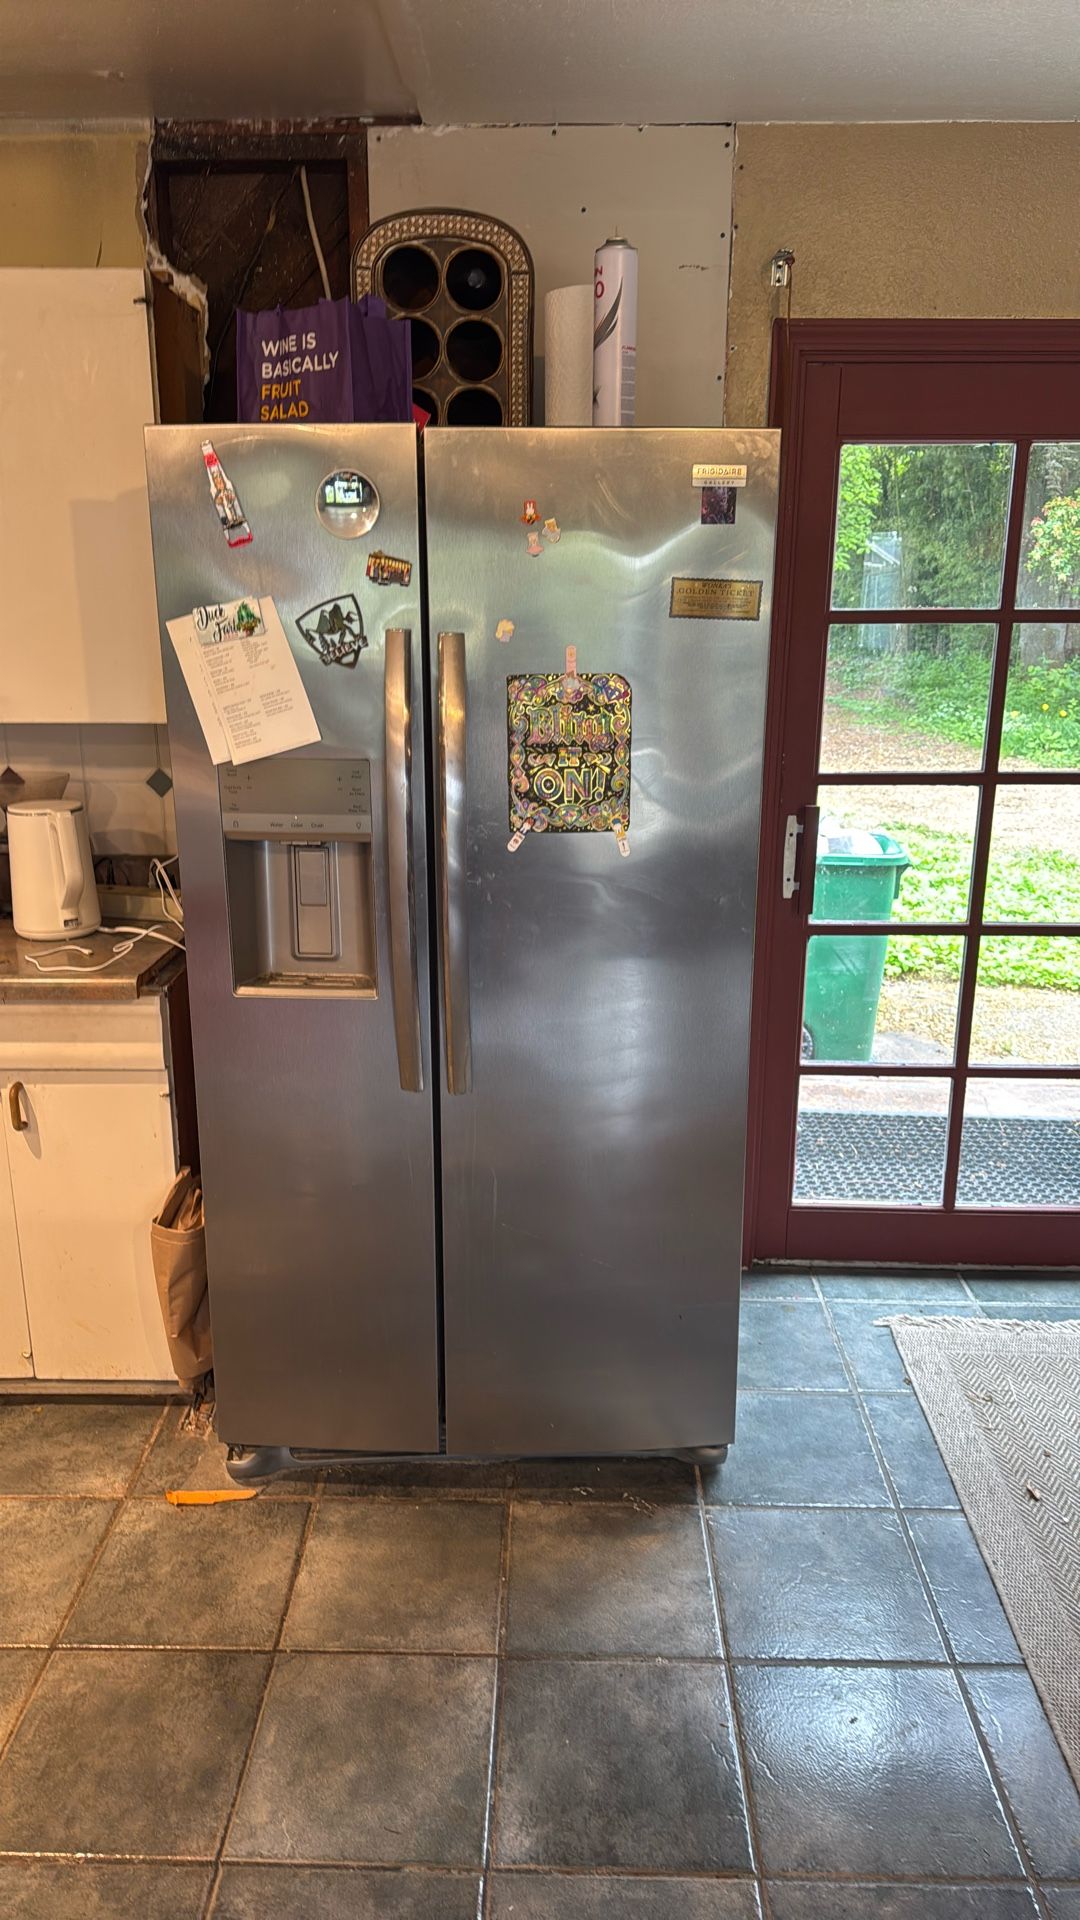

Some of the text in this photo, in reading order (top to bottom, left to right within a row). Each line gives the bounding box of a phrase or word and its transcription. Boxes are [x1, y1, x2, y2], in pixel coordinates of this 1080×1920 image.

[261, 332, 316, 357] WINE IS
[261, 350, 339, 379] BASICALLY
[261, 379, 301, 400] FRUIT
[260, 400, 309, 421] SALAD
[697, 467, 742, 476] FRIGIDAIRE
[678, 587, 754, 597] GOLDEN TICKET
[525, 703, 615, 751] Bling
[558, 746, 582, 767] IT
[533, 767, 606, 801] ON!
